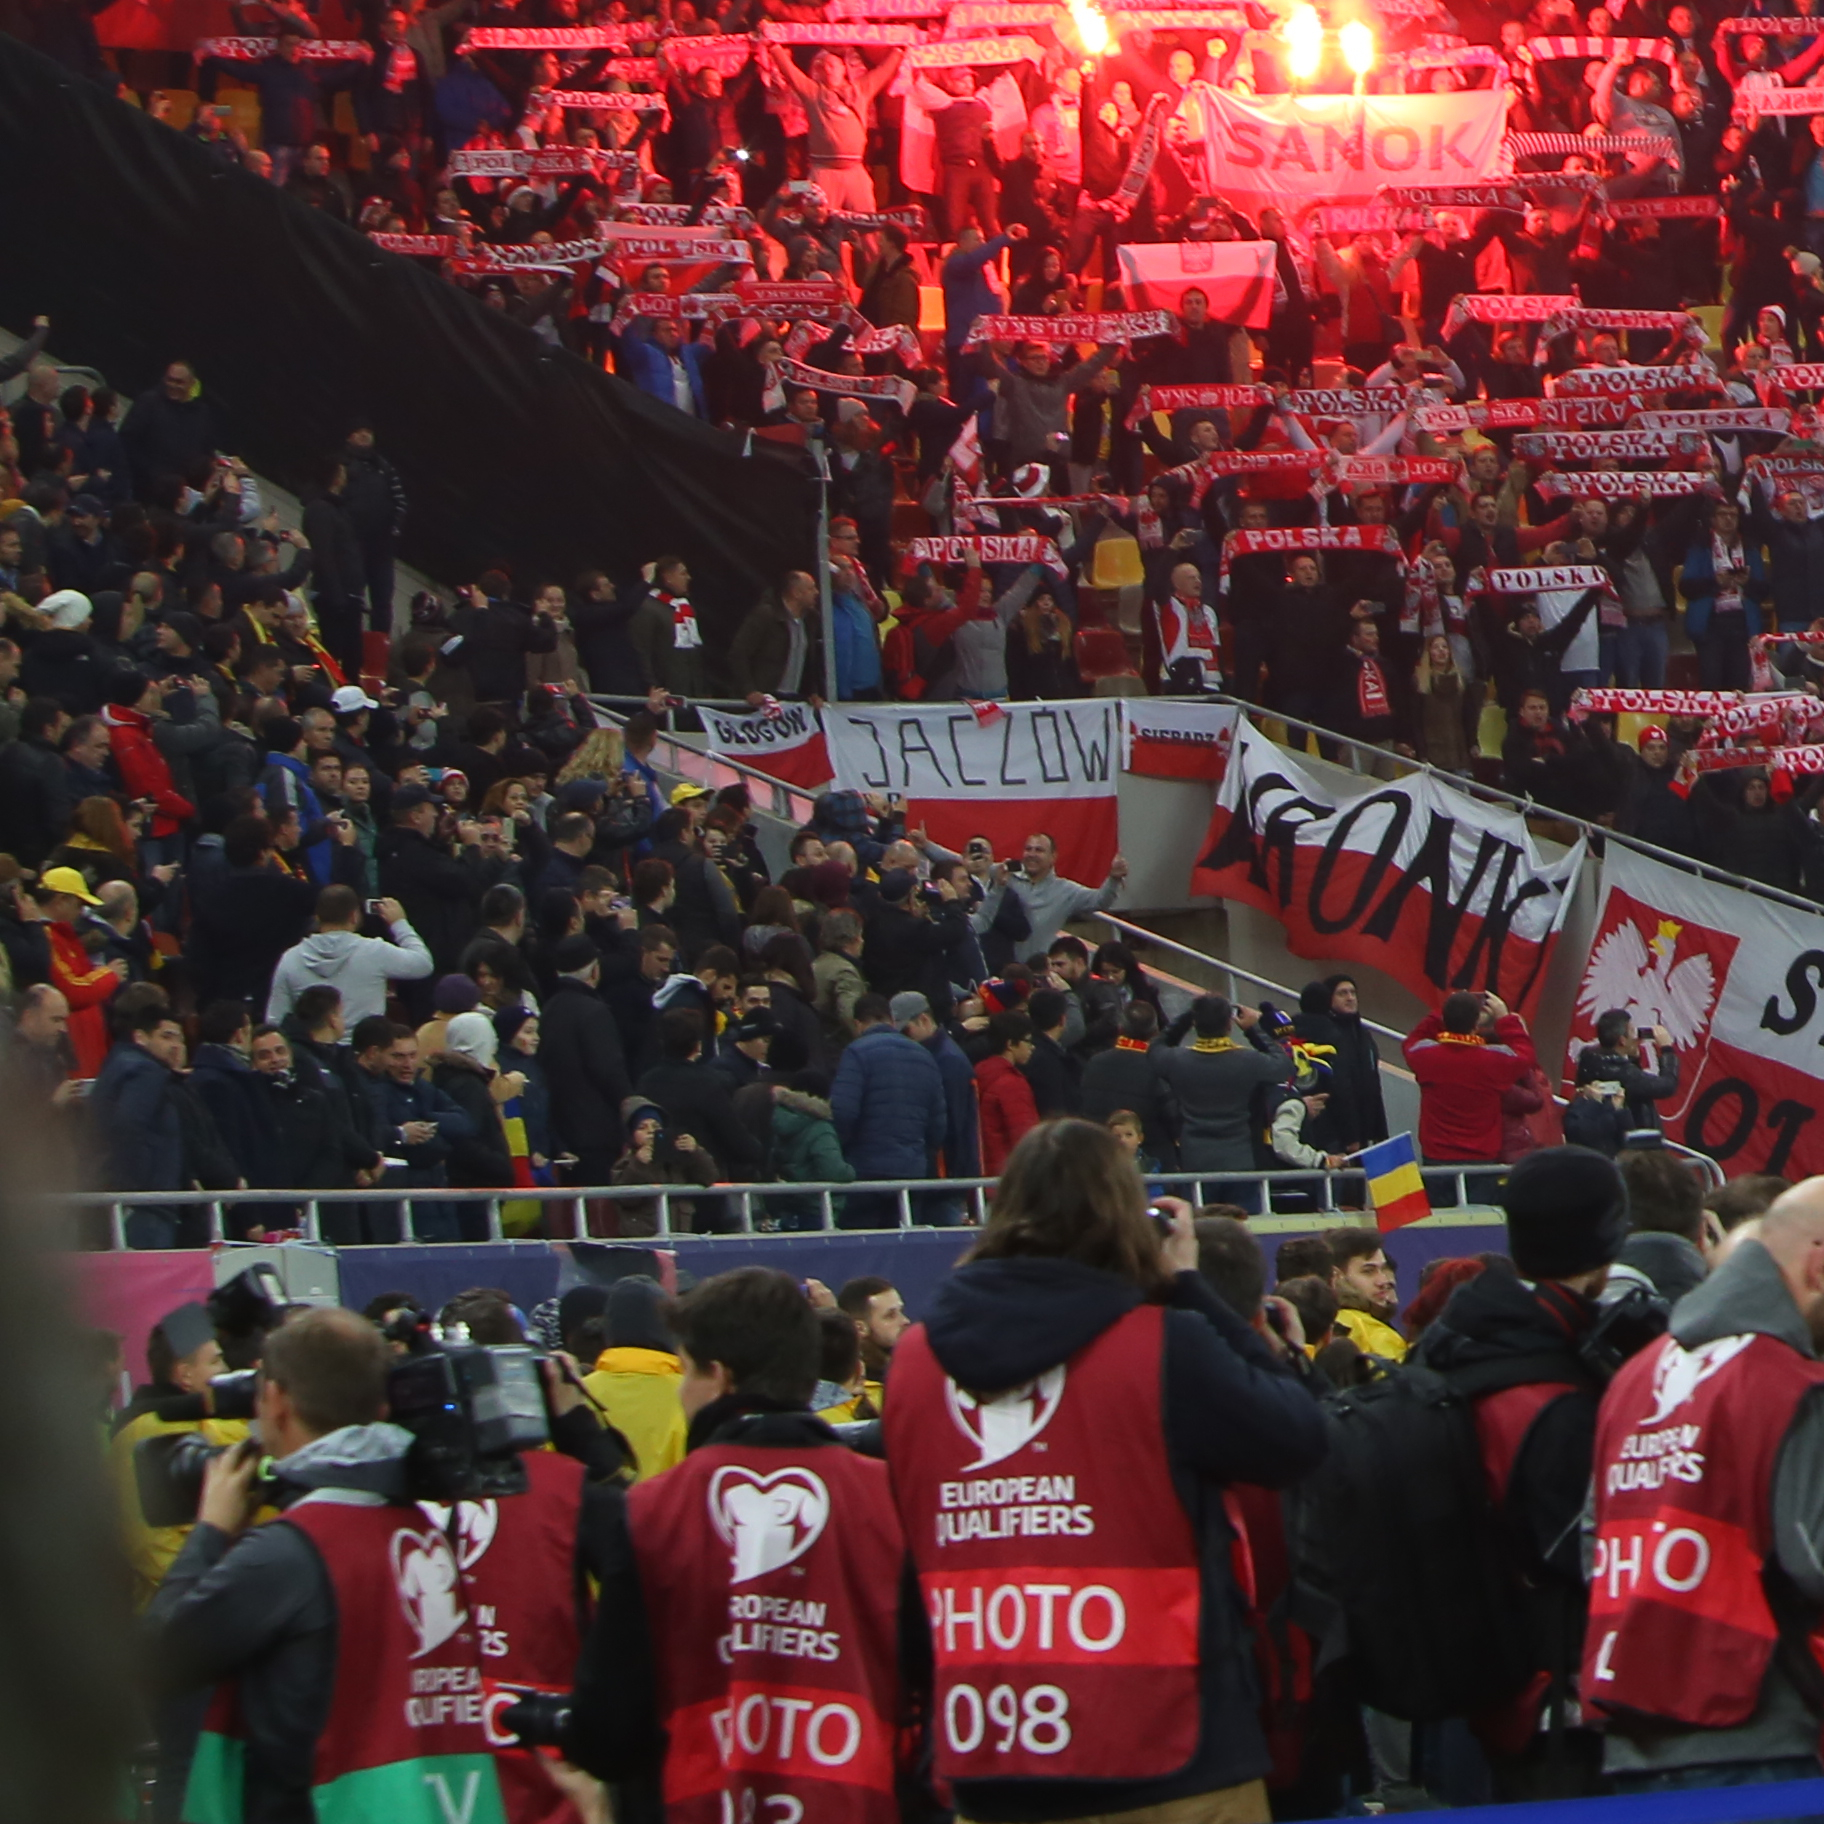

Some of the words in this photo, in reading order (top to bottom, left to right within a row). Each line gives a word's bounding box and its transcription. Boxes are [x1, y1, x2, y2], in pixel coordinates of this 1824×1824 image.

[794, 25, 882, 44] POLSKA
[1224, 120, 1475, 174] SANOK
[1587, 366, 1699, 393] POLSKA
[1301, 389, 1402, 413] POLSKA
[1425, 411, 1466, 426] POL
[1491, 401, 1535, 416] SKA
[1657, 411, 1773, 430] POLSKA
[1555, 432, 1669, 459] POLSKA
[1577, 473, 1698, 495] POLSKA
[932, 535, 1033, 562] POLSKA
[1246, 528, 1363, 548] POLSKA
[1498, 568, 1602, 589] POLSKA
[1599, 691, 1725, 716] POLSKA
[940, 1476, 1075, 1508] EUROPEAN
[730, 1594, 825, 1627] ROPEAN
[944, 1683, 1071, 1754] 098
